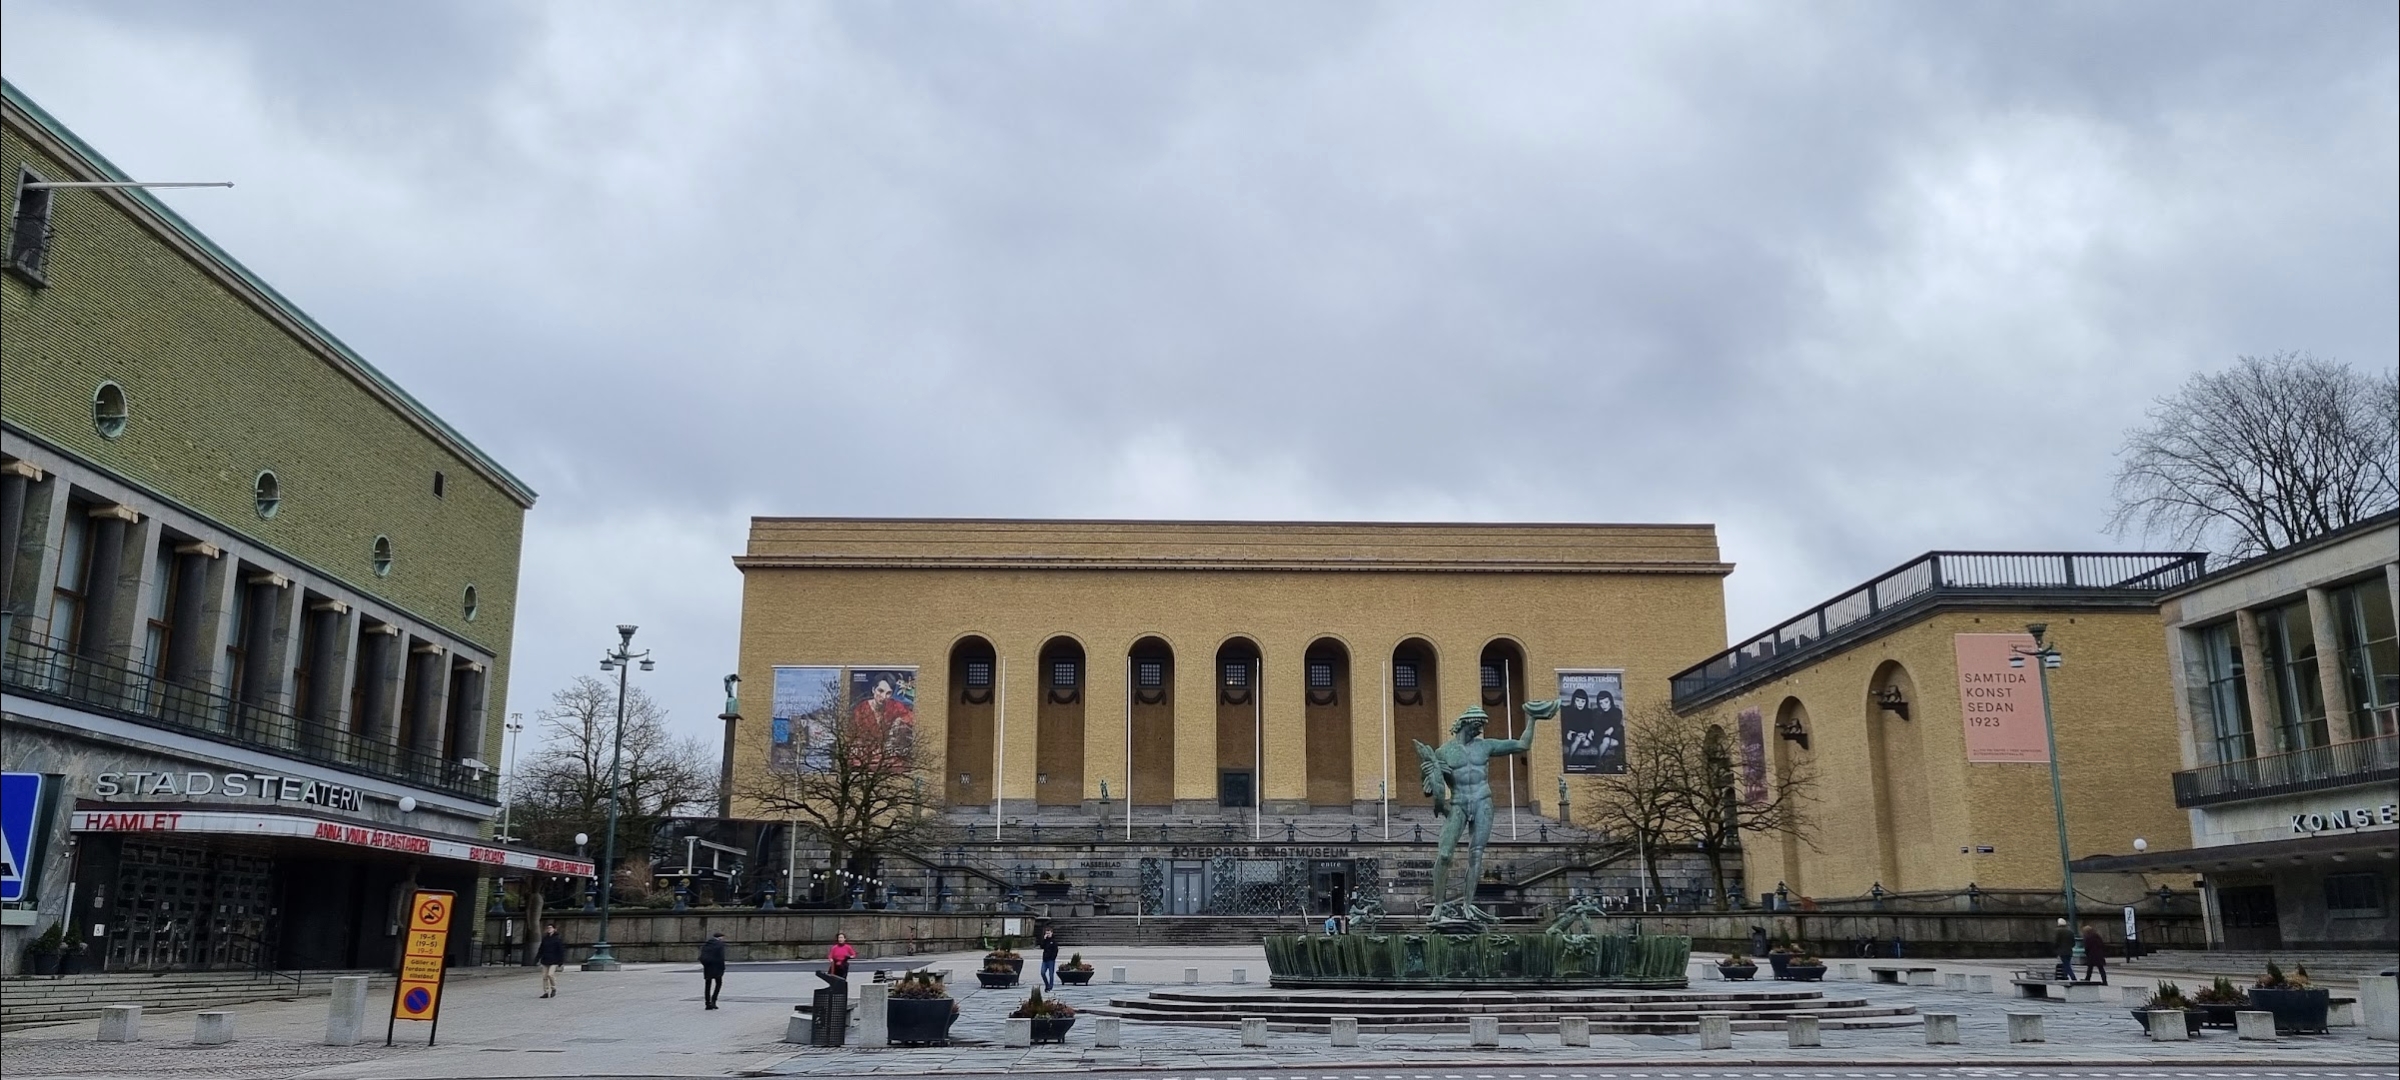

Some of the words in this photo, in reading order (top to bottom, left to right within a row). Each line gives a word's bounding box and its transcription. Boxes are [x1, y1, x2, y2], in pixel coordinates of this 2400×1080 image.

[1964, 673, 2027, 683] SAMTIDA
[1966, 687, 2013, 698] KONST
[1967, 702, 2014, 712] SEDAN
[1969, 717, 2000, 727] 1923
[95, 771, 364, 811] STADSTEATERN
[85, 813, 182, 831] HAMLET
[2290, 804, 2395, 833] KONSE
[315, 822, 343, 841] ANNA
[469, 847, 484, 861] BAD
[1171, 846, 1249, 857] GÖTEBORGS
[1254, 847, 1349, 857] KONSTMUSEUM
[1089, 870, 1114, 878] CENTER
